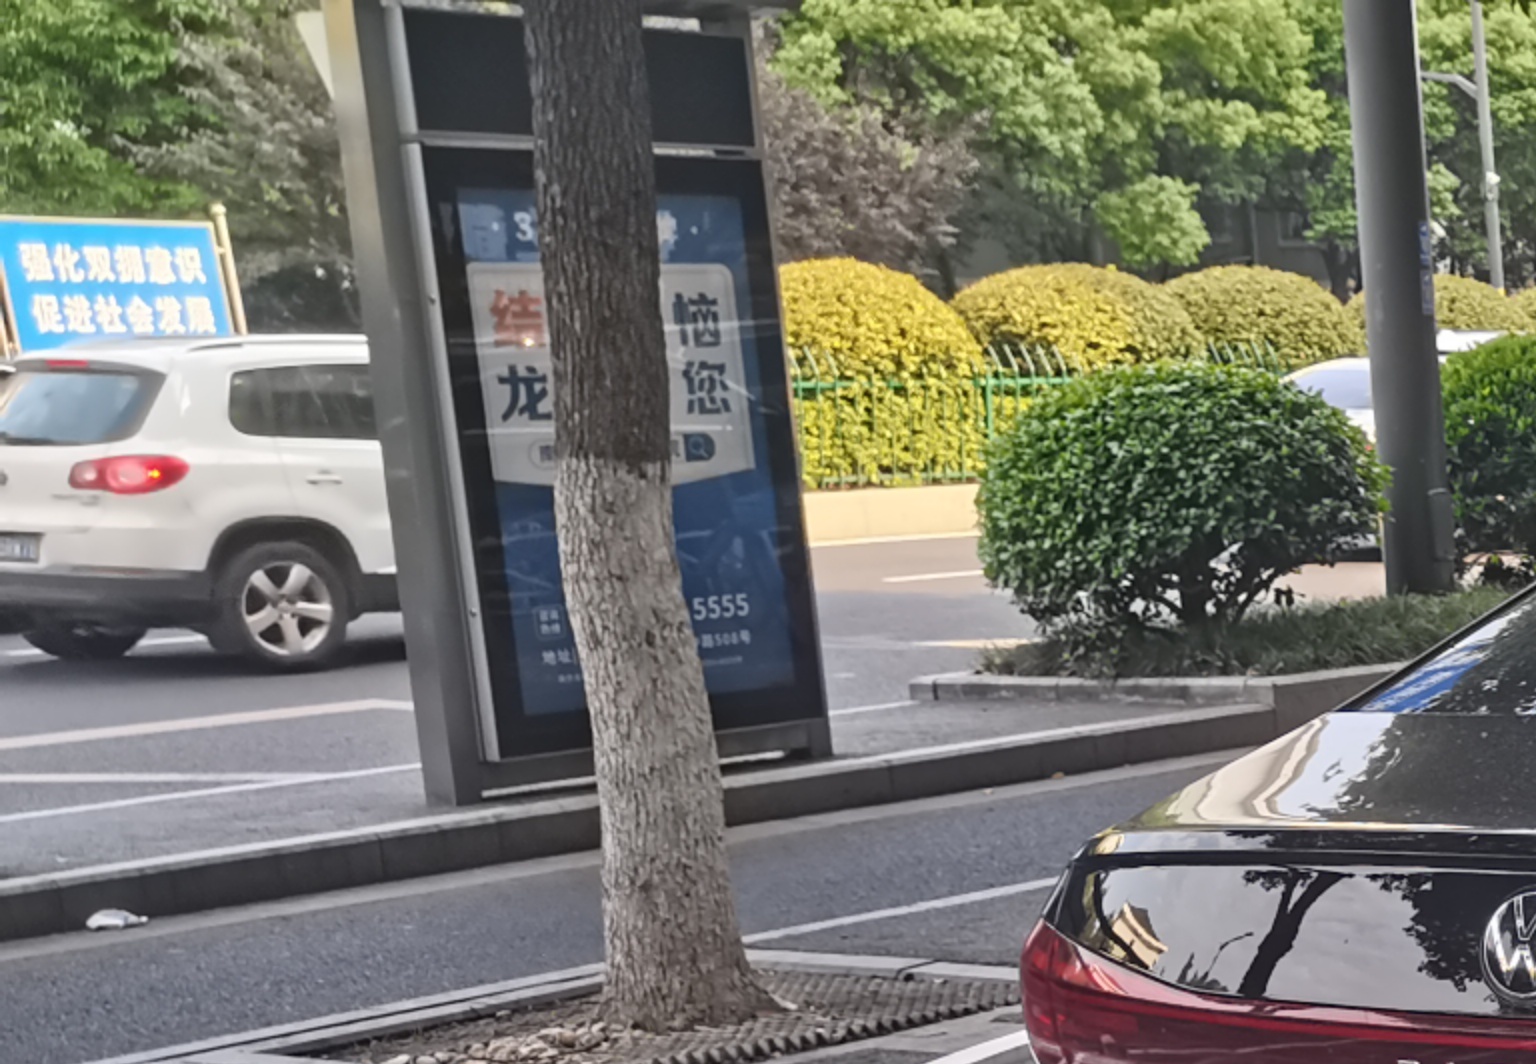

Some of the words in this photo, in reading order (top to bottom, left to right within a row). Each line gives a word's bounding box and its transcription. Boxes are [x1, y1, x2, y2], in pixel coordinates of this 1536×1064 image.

[18, 243, 207, 285] 强化双拥意识
[32, 294, 217, 335] 促进社会发展
[682, 360, 733, 415] 您
[692, 593, 750, 621] 5555
[695, 629, 751, 649] 路508号
